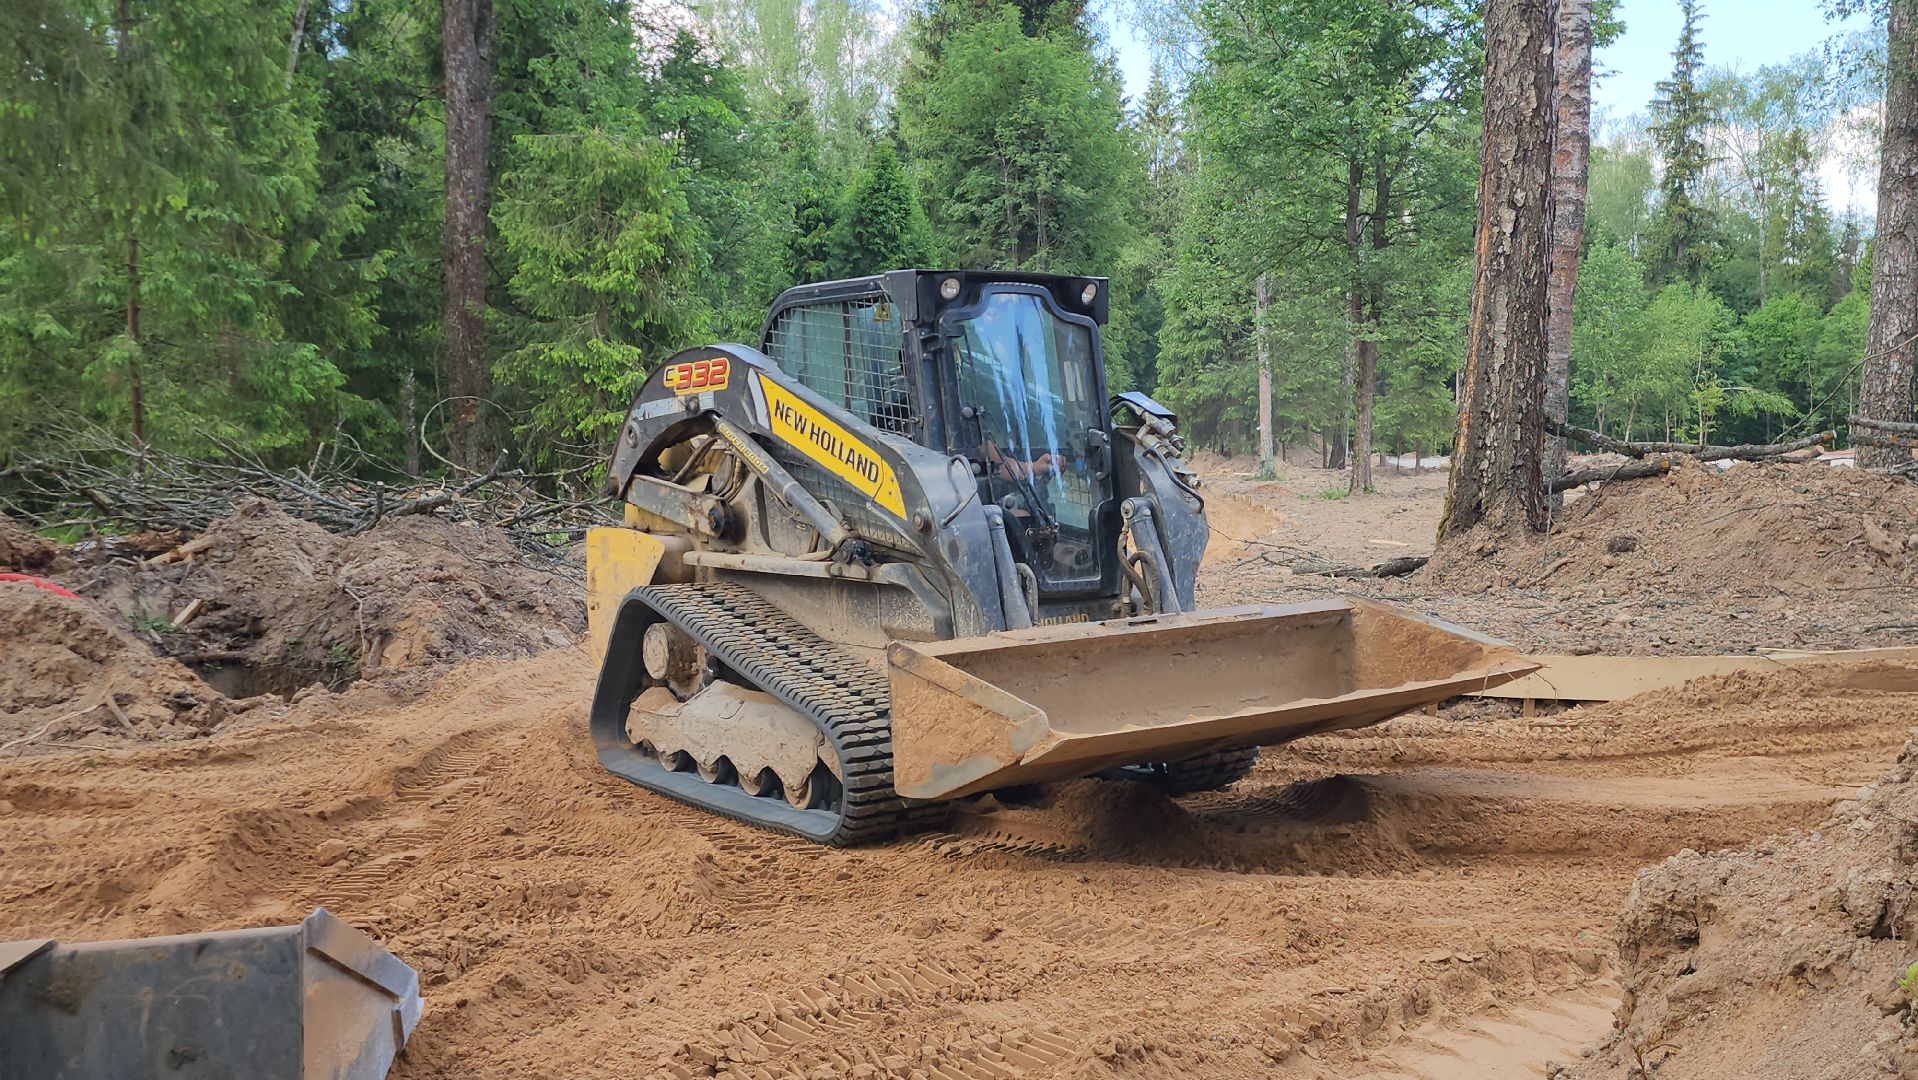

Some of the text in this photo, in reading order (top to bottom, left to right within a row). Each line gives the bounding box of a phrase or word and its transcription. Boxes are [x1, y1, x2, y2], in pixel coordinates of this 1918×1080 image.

[665, 358, 728, 390] C332
[774, 398, 879, 483] NEW HOLLAND
